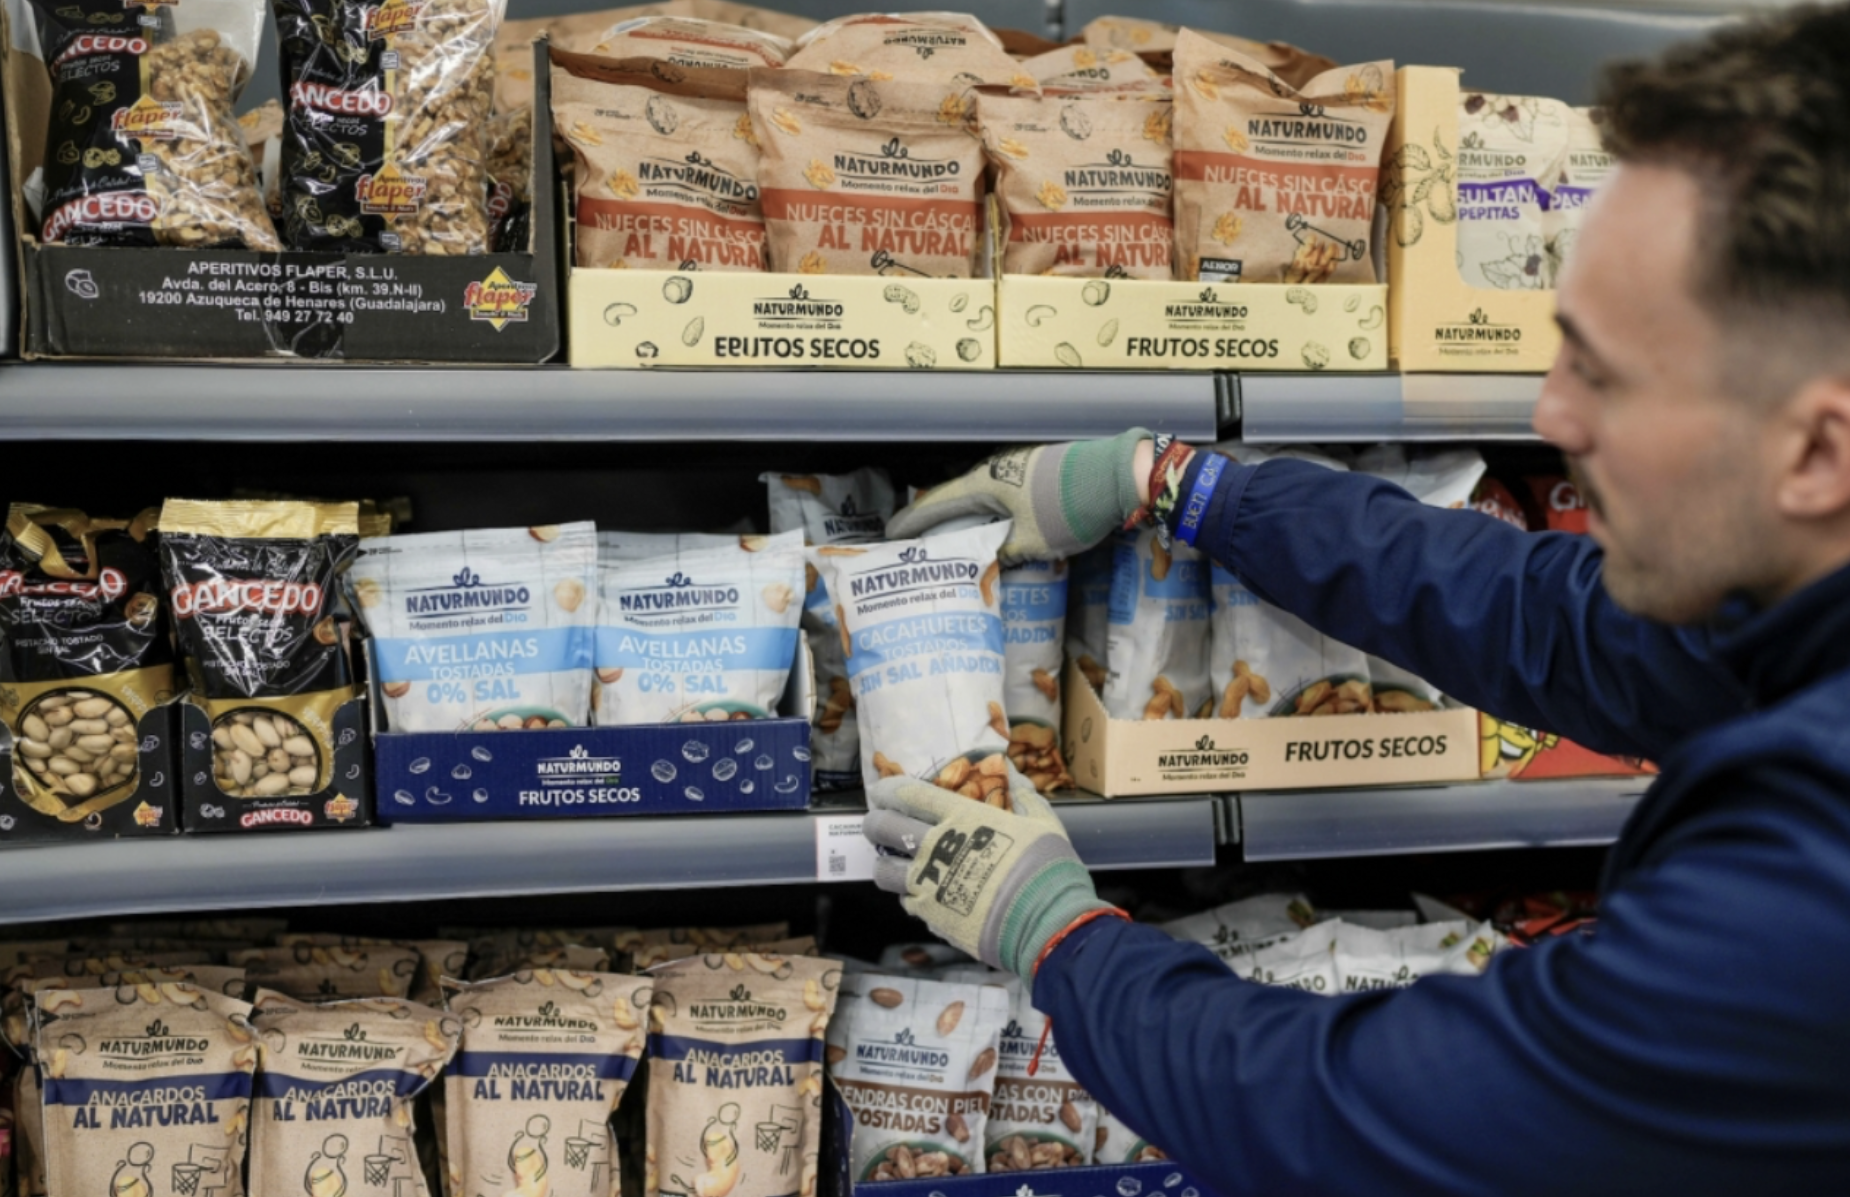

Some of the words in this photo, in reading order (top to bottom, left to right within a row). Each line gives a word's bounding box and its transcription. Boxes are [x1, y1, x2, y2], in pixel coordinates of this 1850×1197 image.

[1248, 120, 1367, 143] NATURMUNDO
[1255, 145, 1303, 159] Momento
[1305, 148, 1330, 159] relax
[1333, 150, 1347, 160] del
[834, 154, 960, 178] NATURMUNDO
[639, 162, 757, 200] NATURMUNDO
[841, 180, 893, 191] Momento
[894, 183, 920, 193] relax
[922, 184, 939, 194] del
[1065, 170, 1171, 191] NATURMUNDO
[1204, 165, 1278, 188] NUECES
[1284, 175, 1315, 192] SIN
[1074, 197, 1121, 207] Momento
[1123, 197, 1145, 206] relax
[1234, 186, 1266, 211] AL
[786, 203, 866, 224] NUECES
[872, 209, 905, 229] SIN
[1459, 206, 1520, 220] PEPITAS
[594, 212, 672, 234] NUECES
[678, 218, 708, 238] SIN
[1022, 226, 1098, 244] NUECES
[1104, 225, 1134, 242] SIN
[623, 233, 657, 259] AL
[818, 225, 851, 250] AL
[862, 227, 969, 258] NATURAL
[1054, 244, 1085, 266] AL
[188, 261, 282, 277] APERITIVOS
[285, 265, 351, 281] FLAPER,
[355, 266, 398, 280] S.L.U.
[161, 277, 204, 291] Avda.
[210, 279, 230, 292] del
[286, 281, 295, 292] 8
[309, 281, 333, 294] Bis
[337, 282, 368, 297] (km.
[465, 282, 534, 312] flaper
[139, 291, 182, 305] 19200
[186, 293, 260, 309] Azuqueca
[263, 294, 281, 307] de
[285, 295, 346, 308] Henares
[349, 297, 446, 313] (Guadalajara)
[754, 303, 843, 316] NATURMUNDO
[1165, 305, 1248, 318] NATURMUNDO
[235, 308, 261, 321] Tel.
[265, 309, 290, 322] 949
[295, 310, 312, 322] 27
[316, 311, 333, 323] 72
[336, 312, 354, 323] 40
[1435, 328, 1521, 340] NATURMUNDO
[810, 338, 880, 358] SECOS
[1127, 337, 1209, 357] FRUTOS
[1214, 338, 1279, 358] SECOS
[851, 563, 978, 597] NATURMUNDO
[172, 583, 320, 614] GANCEDO
[406, 587, 530, 613] NATURMUNDO
[620, 588, 739, 610] NATURMUNDO
[857, 597, 908, 616] Momento
[910, 592, 937, 604] relax
[940, 588, 956, 599] del
[409, 619, 459, 631] Momento
[461, 616, 486, 627] relax
[488, 614, 503, 624] del
[624, 615, 670, 627] Momento
[672, 614, 697, 625] relax
[698, 614, 713, 622] del
[858, 615, 987, 651] CACAHUETES
[404, 638, 538, 665] AVELLANAS
[618, 635, 746, 659] AVELLANAS
[884, 638, 968, 661] TOSTADOS
[430, 662, 514, 681] TOSTADAS
[642, 658, 723, 673] TOSTADAS
[638, 673, 675, 692] 0%
[685, 674, 728, 693] SAL
[860, 671, 882, 695] SIN
[886, 661, 922, 682] SAL
[427, 683, 466, 704] 0%
[475, 679, 521, 701] SAL
[1284, 739, 1374, 762] FRUTOS
[1378, 735, 1447, 758] SECOS
[538, 761, 620, 774] NATURMUNDO
[1158, 752, 1249, 767] NATURMUNDO
[519, 789, 584, 806] FRUTOS
[589, 788, 640, 803] SECOS
[240, 810, 312, 827] GANCEDO
[690, 1004, 786, 1021] NATURMUNDO
[494, 1016, 598, 1031] NATURMUNDO
[100, 1038, 208, 1055] NATURMUNDO
[541, 1035, 562, 1043] relax
[564, 1035, 578, 1043] del
[298, 1042, 403, 1059] NATURMUND
[685, 1048, 784, 1067] ANACARDOS
[856, 1044, 948, 1066] NATURMUNDO
[171, 1058, 184, 1066] del
[487, 1062, 596, 1079] ANACARDOS
[673, 1062, 697, 1083] AL
[706, 1065, 795, 1088] NATURAL
[88, 1086, 205, 1107] ANACARDOS
[283, 1080, 396, 1103] ANACARDOS
[473, 1079, 502, 1099] AL
[511, 1079, 605, 1101] NATURAL
[841, 1087, 907, 1108] ENDRAS
[911, 1094, 948, 1113] CON
[1023, 1085, 1063, 1103] CON
[73, 1107, 101, 1128] AL
[111, 1103, 219, 1129] NATURAL
[273, 1100, 295, 1121] AL
[306, 1096, 392, 1121] NATURA
